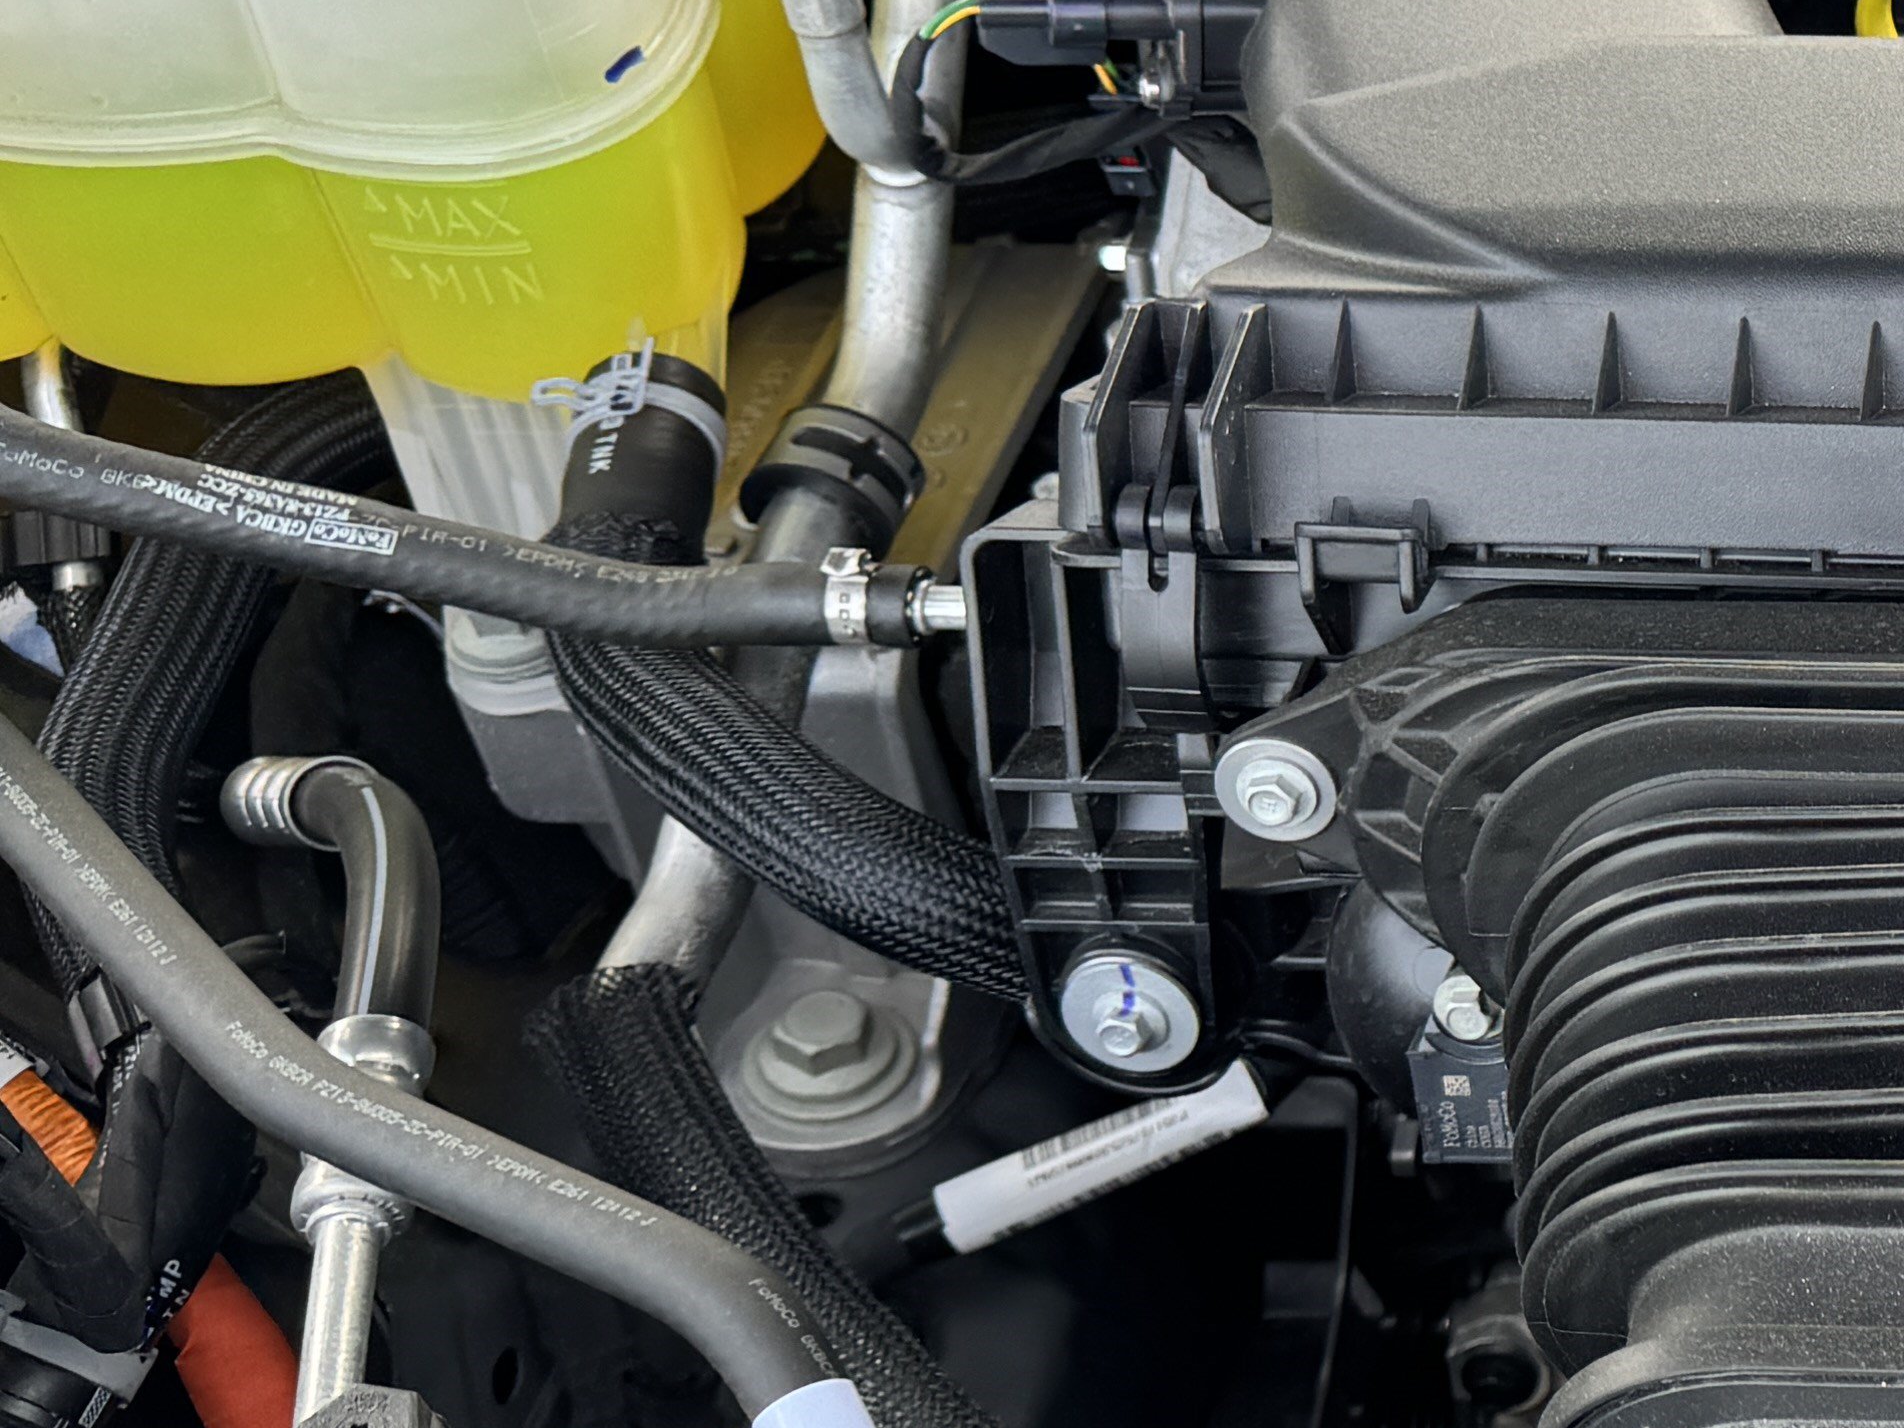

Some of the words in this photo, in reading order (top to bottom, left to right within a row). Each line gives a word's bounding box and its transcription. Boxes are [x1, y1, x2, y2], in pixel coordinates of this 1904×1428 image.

[395, 192, 522, 238] MAX
[419, 262, 545, 306] MIN
[312, 521, 396, 550] FoMoCo
[1438, 1100, 1461, 1148] FoMoCo
